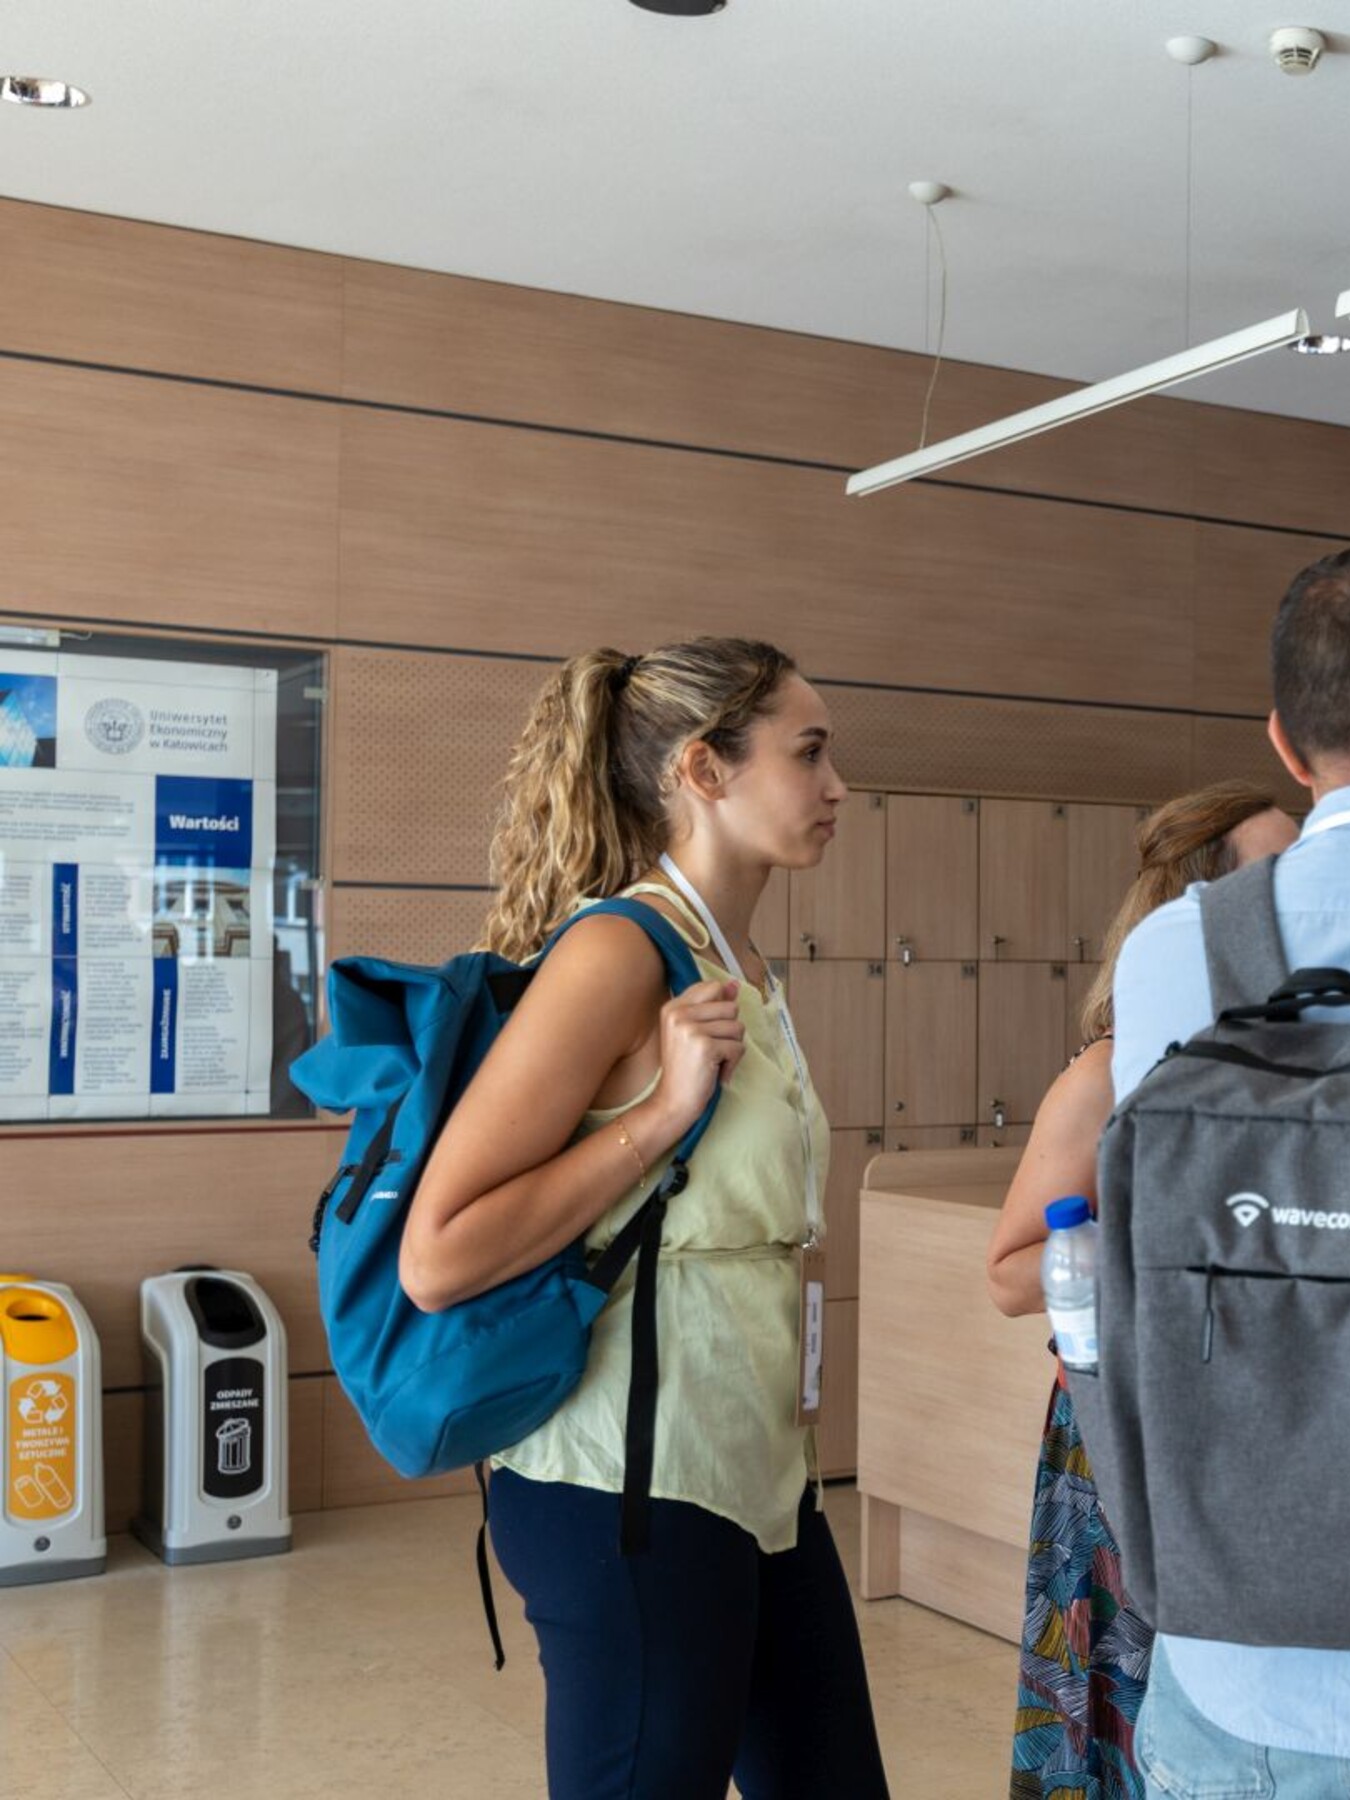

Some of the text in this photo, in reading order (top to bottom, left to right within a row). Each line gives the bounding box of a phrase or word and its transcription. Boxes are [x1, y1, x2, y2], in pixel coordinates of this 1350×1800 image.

[150, 709, 227, 726] Uniwersytet
[150, 724, 227, 740] Ekonomiczny
[149, 739, 227, 752] w Katowicach
[169, 814, 239, 831] Wartości
[216, 1389, 253, 1400] ODPADY
[210, 1399, 259, 1411] ZMIESZANE
